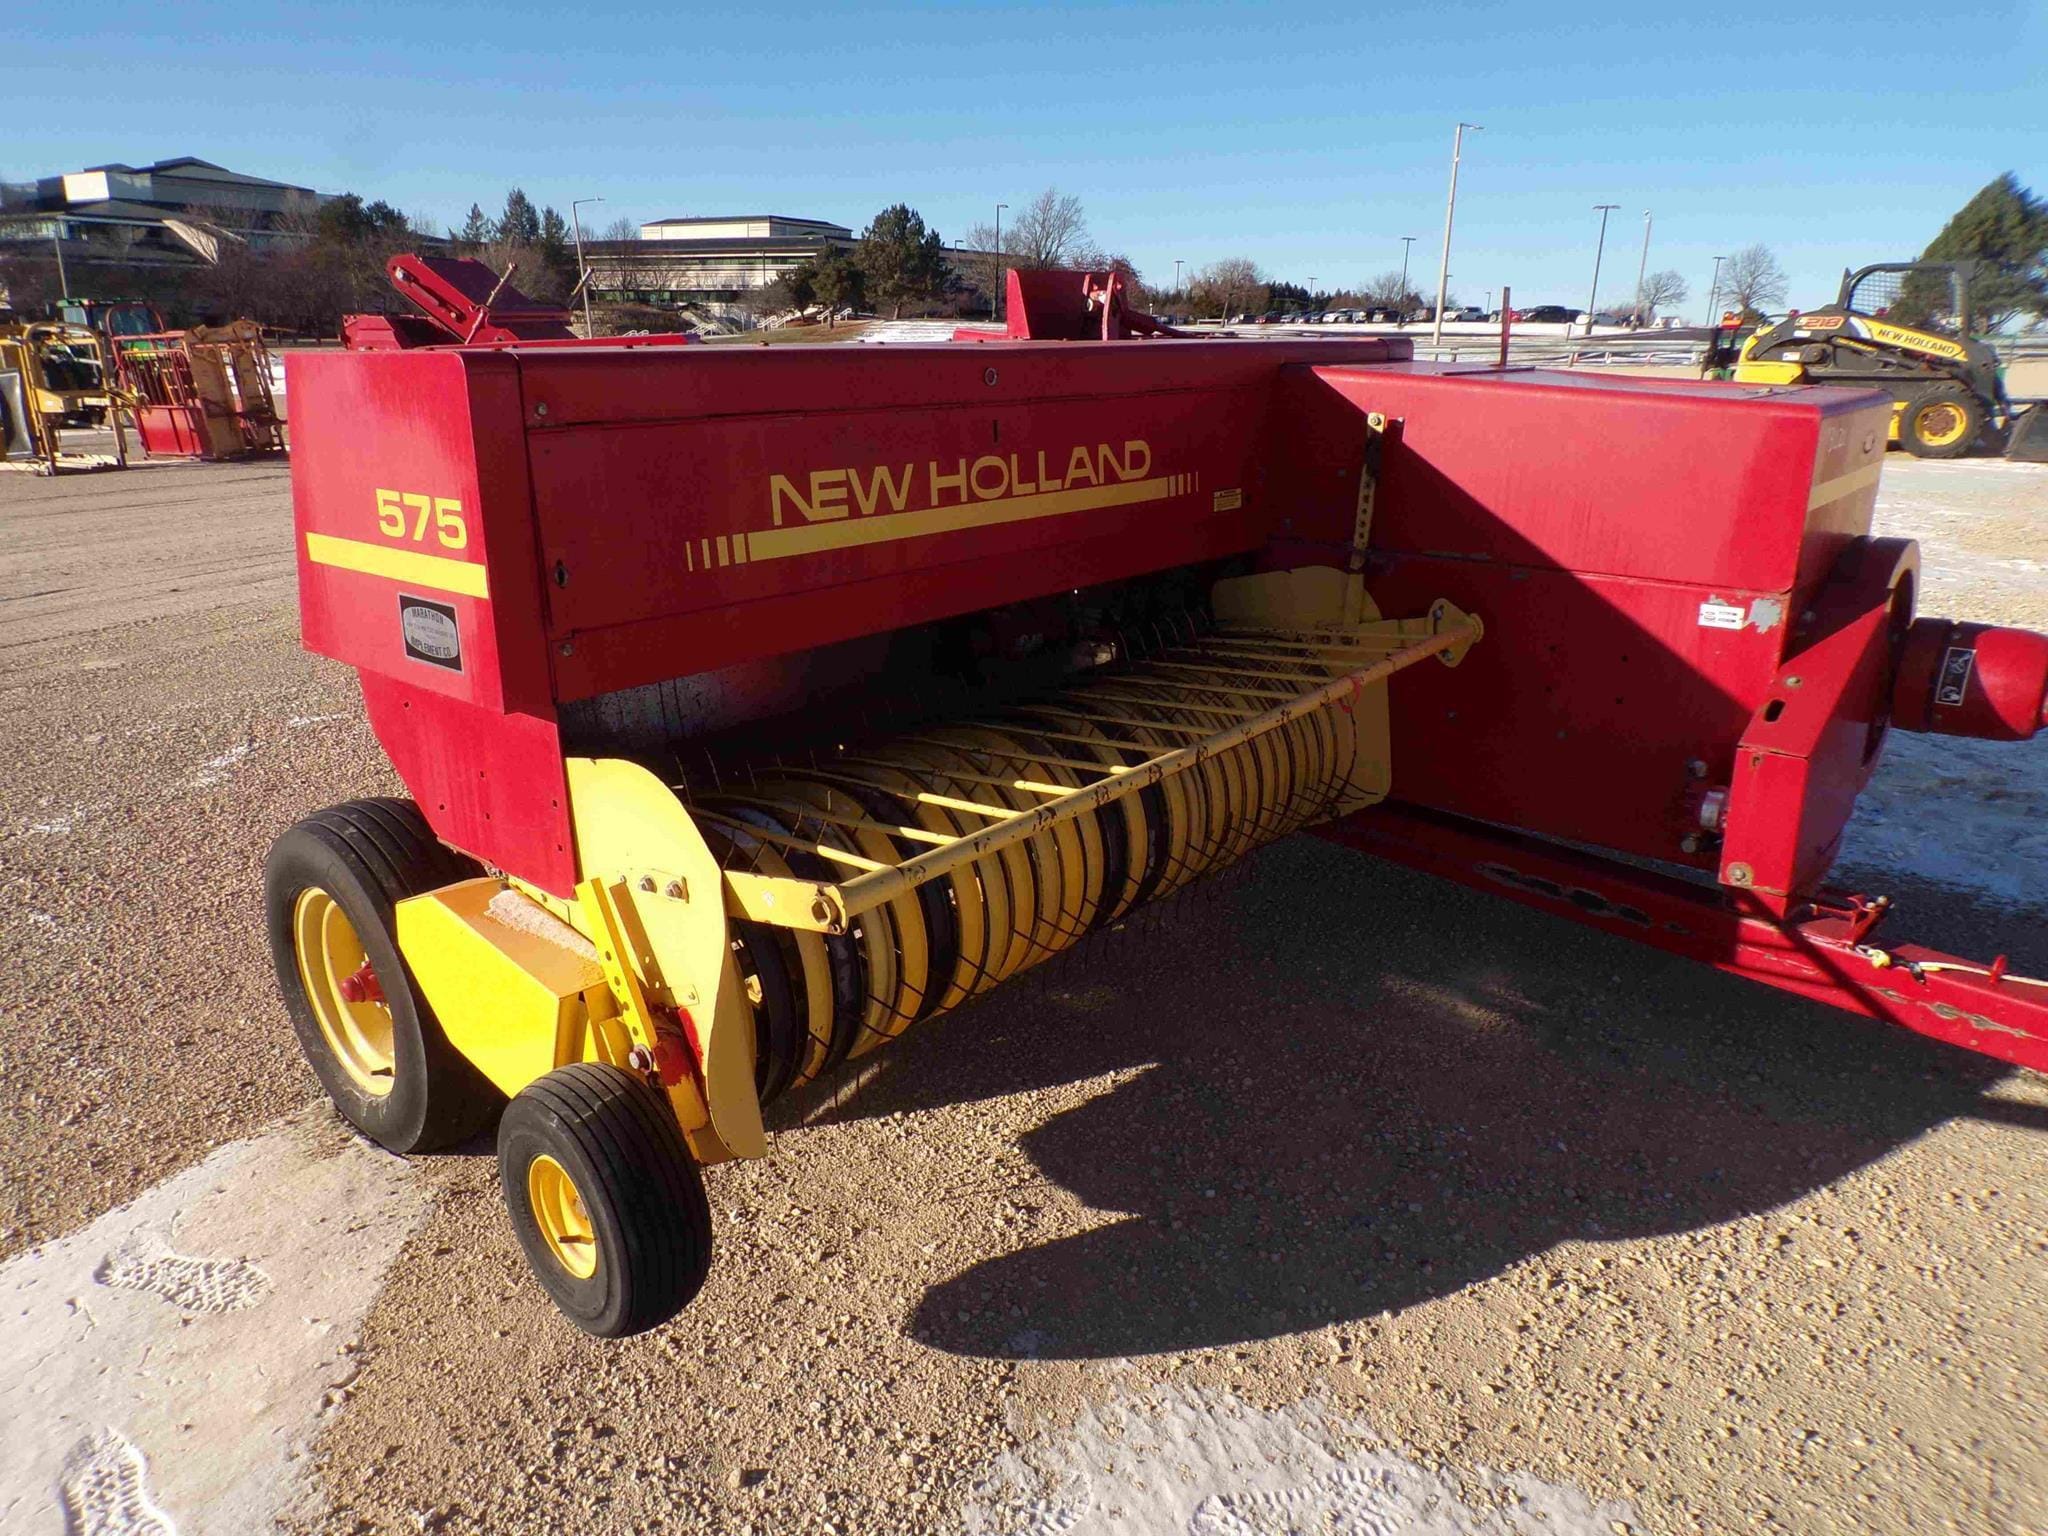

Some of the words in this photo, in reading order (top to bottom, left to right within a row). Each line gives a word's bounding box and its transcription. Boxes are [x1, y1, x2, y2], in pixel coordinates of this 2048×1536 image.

[1878, 328, 1902, 342] NEW
[1905, 335, 1955, 355] HOLLAND
[770, 463, 913, 526] NEW
[929, 440, 1151, 506] HOLLAND
[376, 488, 467, 549] 575
[411, 607, 444, 624] MARATHON
